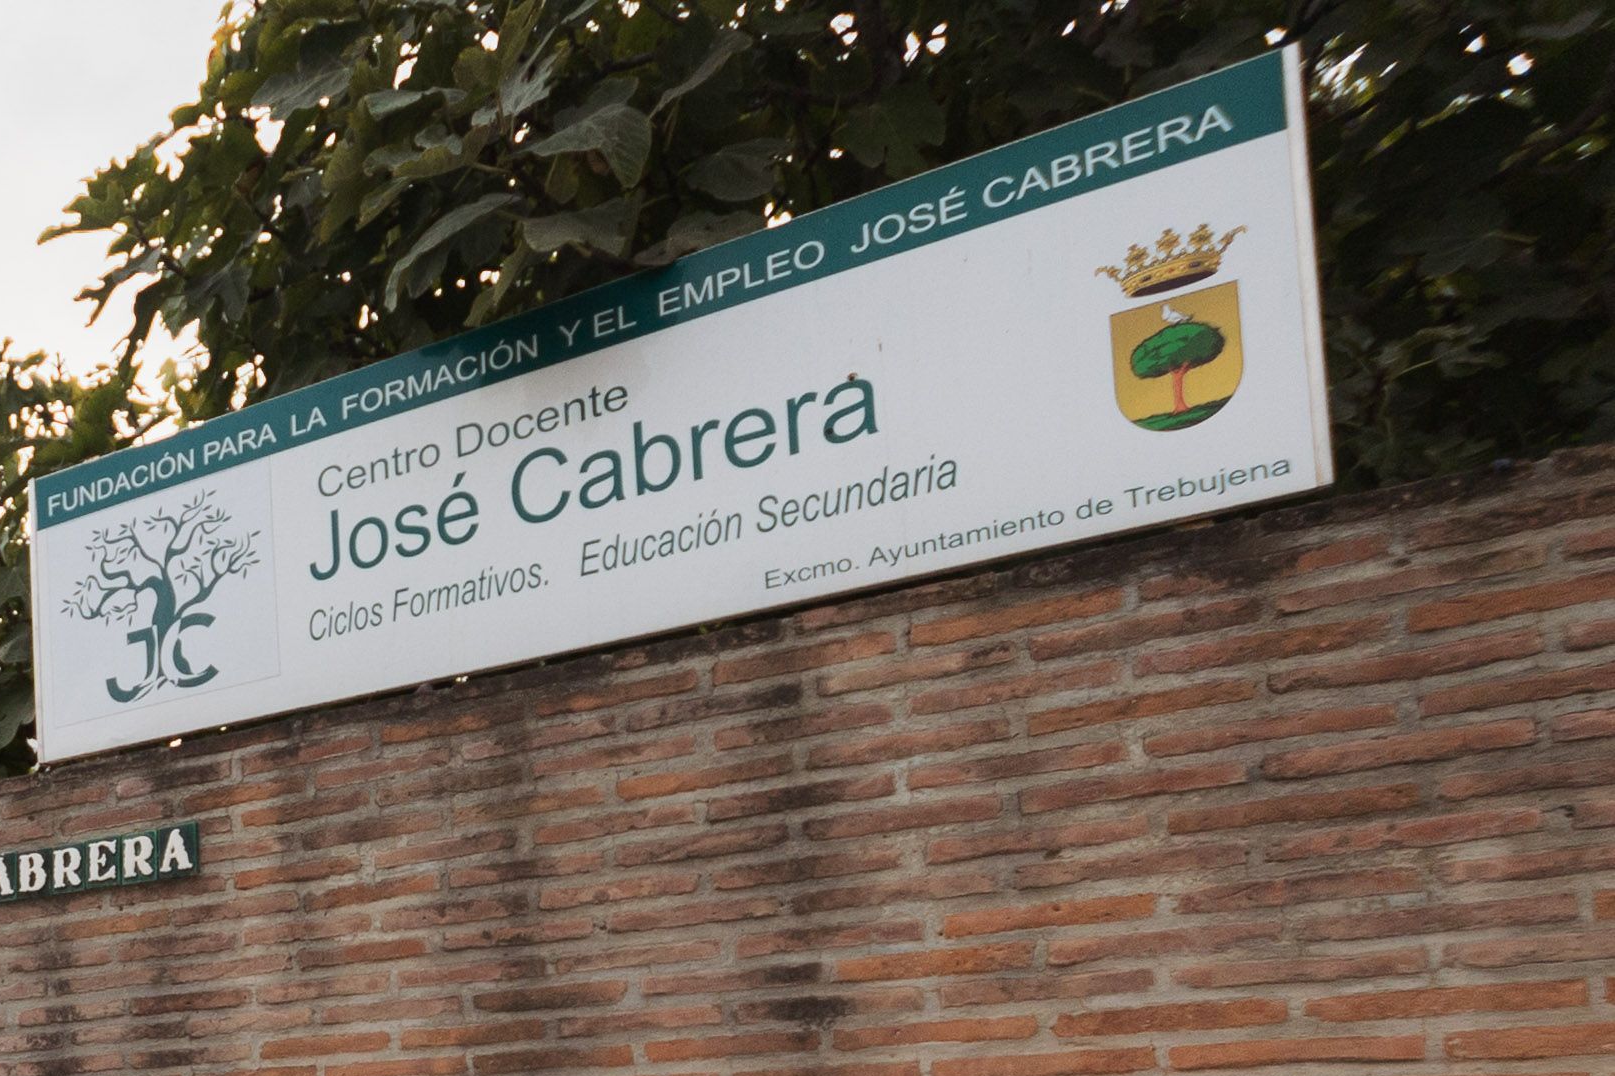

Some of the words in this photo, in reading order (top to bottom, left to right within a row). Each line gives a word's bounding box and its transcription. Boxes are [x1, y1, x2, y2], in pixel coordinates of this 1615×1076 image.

[46, 452, 195, 516] FUNDACIÓN
[202, 422, 277, 465] PARA
[289, 404, 327, 437] LA
[341, 335, 538, 420] FORMACIÓN
[559, 320, 584, 348] Y
[593, 313, 637, 339] EL
[657, 239, 825, 317] EMPLEO
[850, 187, 968, 254] JOSÉ
[982, 105, 1233, 208] CABRERA
[309, 474, 479, 582] José
[510, 374, 879, 525] Cabrera
[317, 443, 441, 498] Centro
[455, 385, 629, 458] Docente
[764, 562, 860, 590] Excmo.
[869, 506, 1066, 567] Ayuntamiento
[1075, 497, 1113, 520] de
[1123, 457, 1292, 510] Trebujena
[308, 602, 383, 641] Ciclos
[392, 561, 550, 622] Formativos.
[579, 509, 743, 577] Educación
[756, 453, 958, 535] Secundaria
